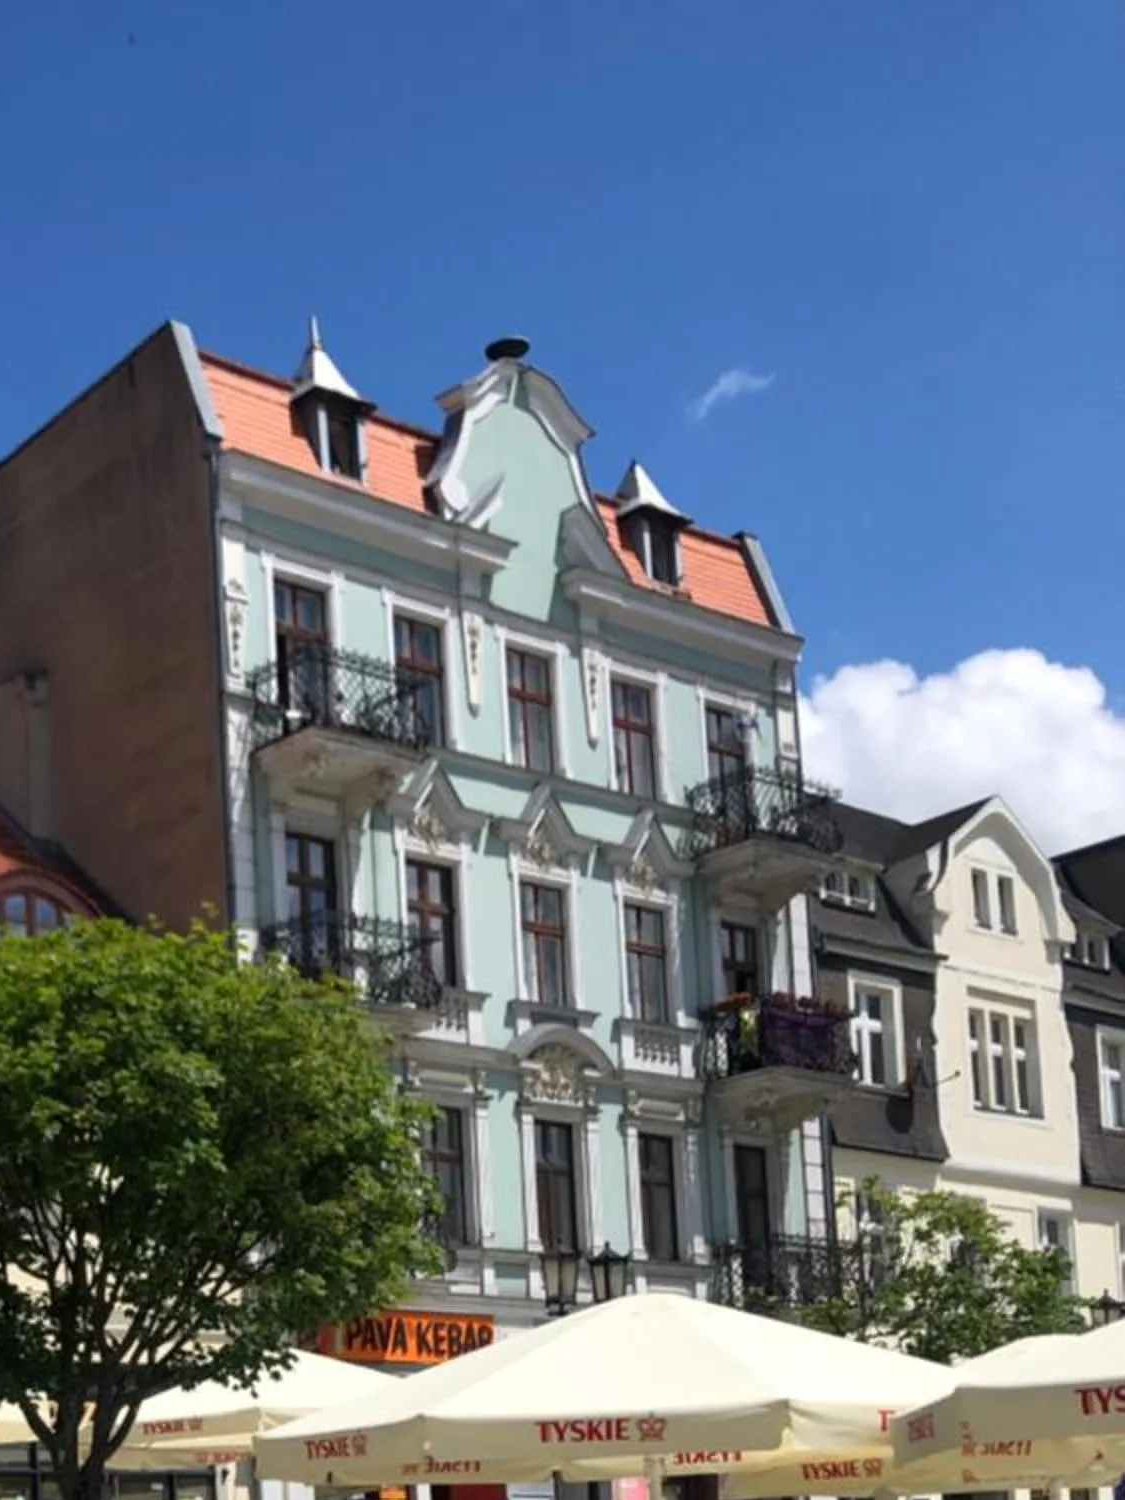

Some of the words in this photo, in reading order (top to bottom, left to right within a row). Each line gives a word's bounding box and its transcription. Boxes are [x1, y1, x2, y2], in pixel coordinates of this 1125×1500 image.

[535, 1418, 630, 1443] TYSKIE
[304, 1437, 349, 1460] TYSKIE
[801, 1460, 860, 1480] TYSKIE
